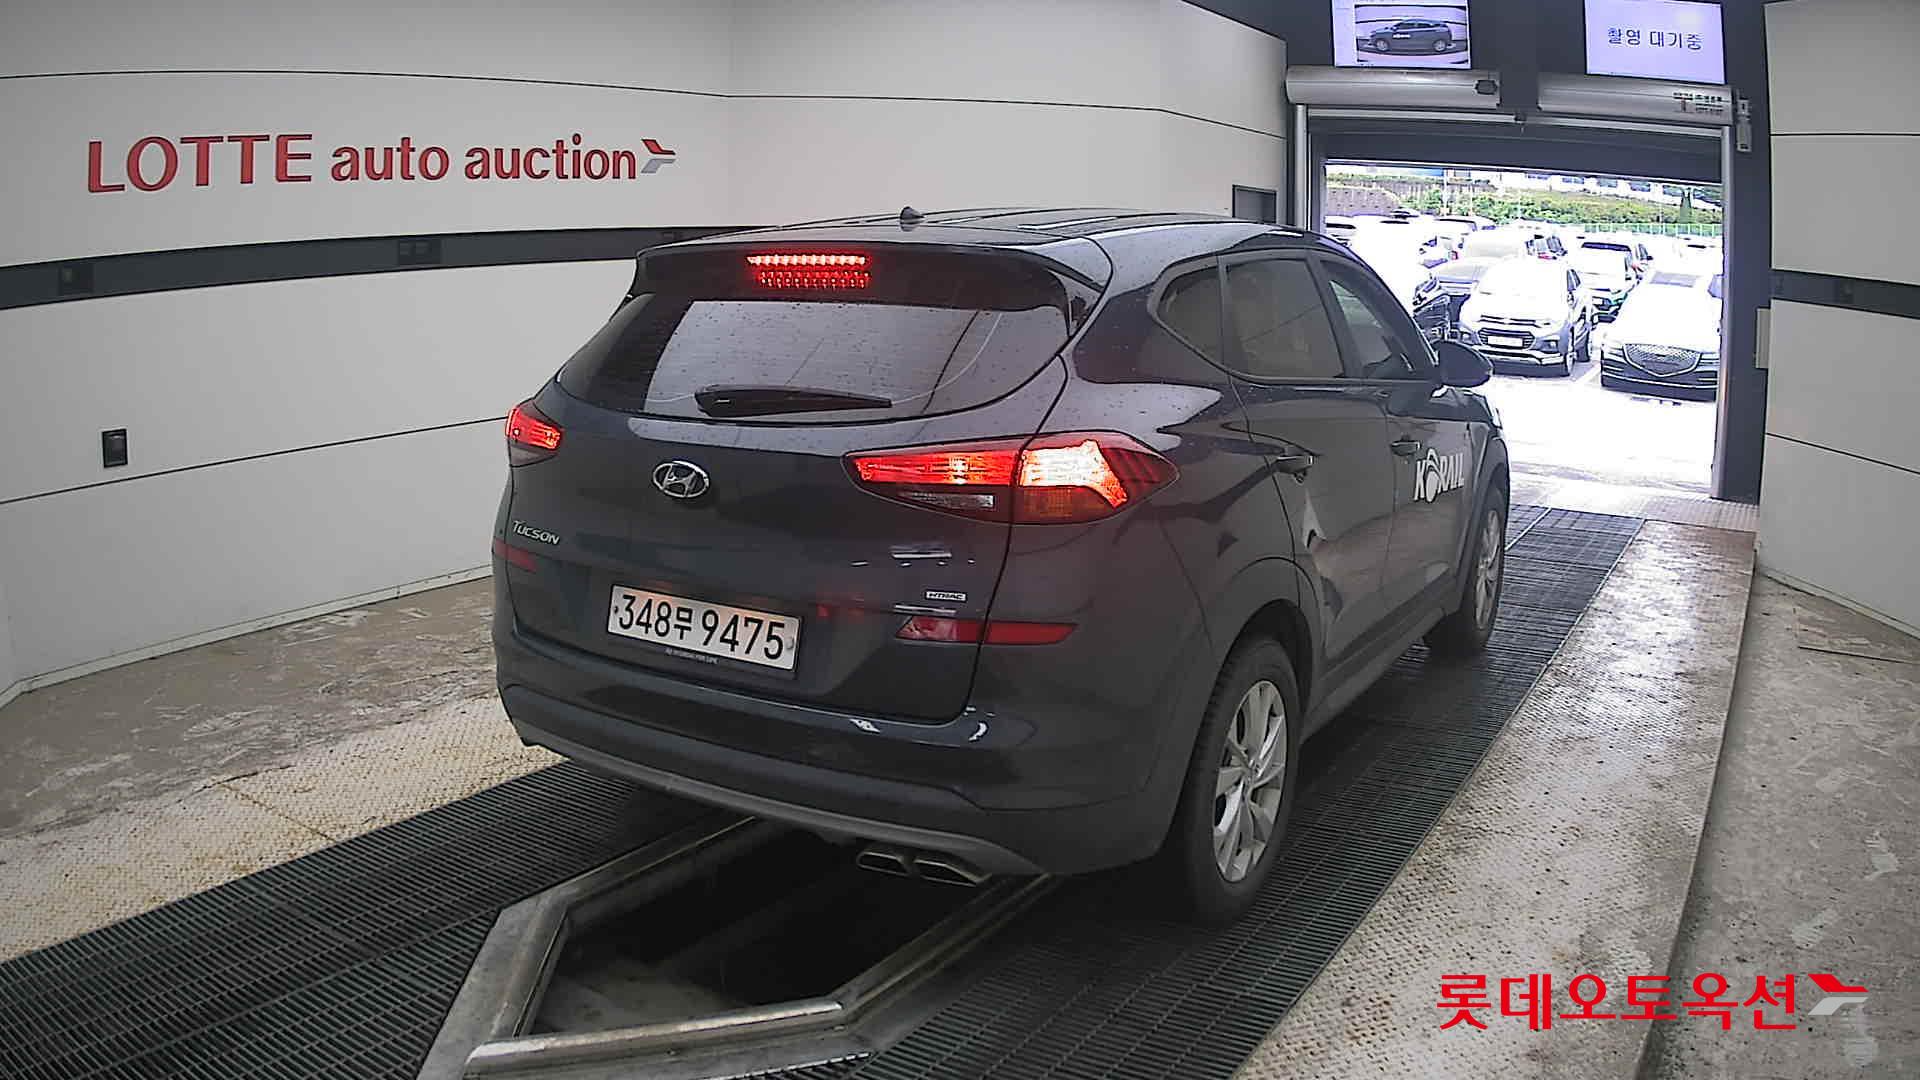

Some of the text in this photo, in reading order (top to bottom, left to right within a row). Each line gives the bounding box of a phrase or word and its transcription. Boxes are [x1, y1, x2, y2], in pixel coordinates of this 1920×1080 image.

[1608, 28, 1702, 51] 촬영 대기중
[88, 133, 637, 193] LOTTE auto auction
[619, 594, 785, 660] 348무 9475
